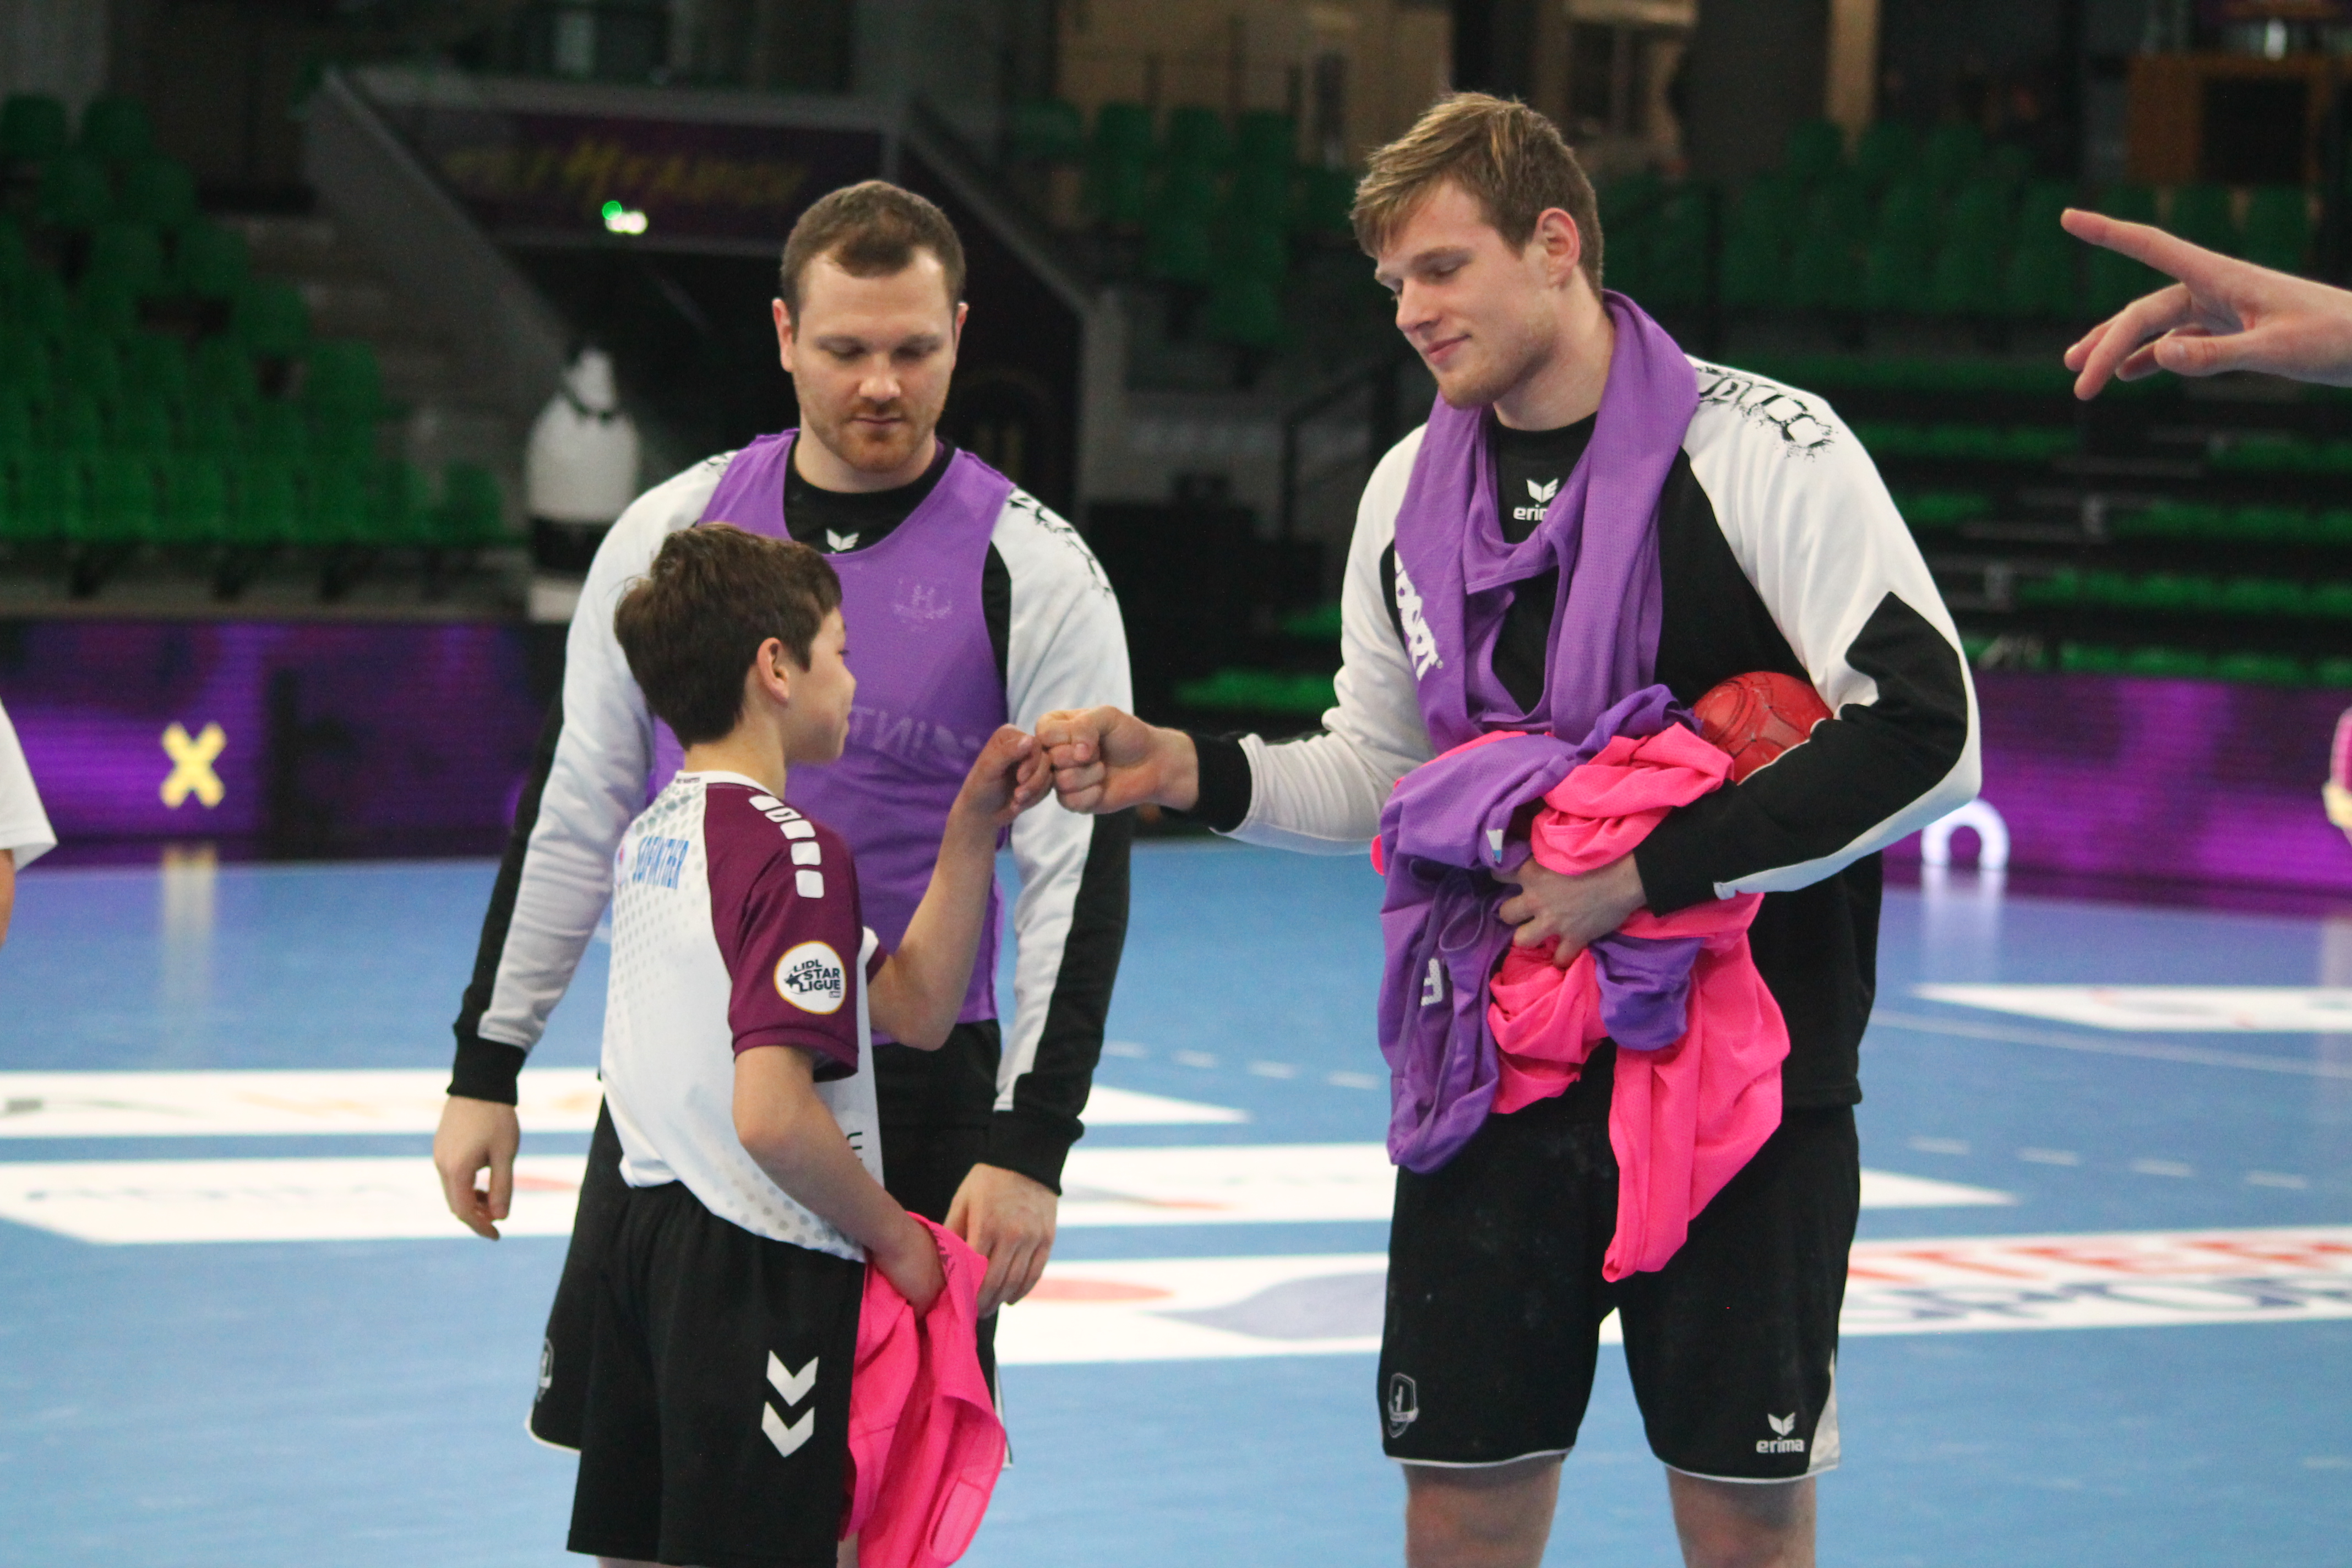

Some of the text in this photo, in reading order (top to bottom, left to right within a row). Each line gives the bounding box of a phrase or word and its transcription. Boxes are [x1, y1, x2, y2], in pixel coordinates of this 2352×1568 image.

[794, 959, 823, 972] LIDL
[804, 968, 840, 980] STAR
[799, 980, 841, 993] LIGUE
[1756, 1436, 1804, 1453] erima
